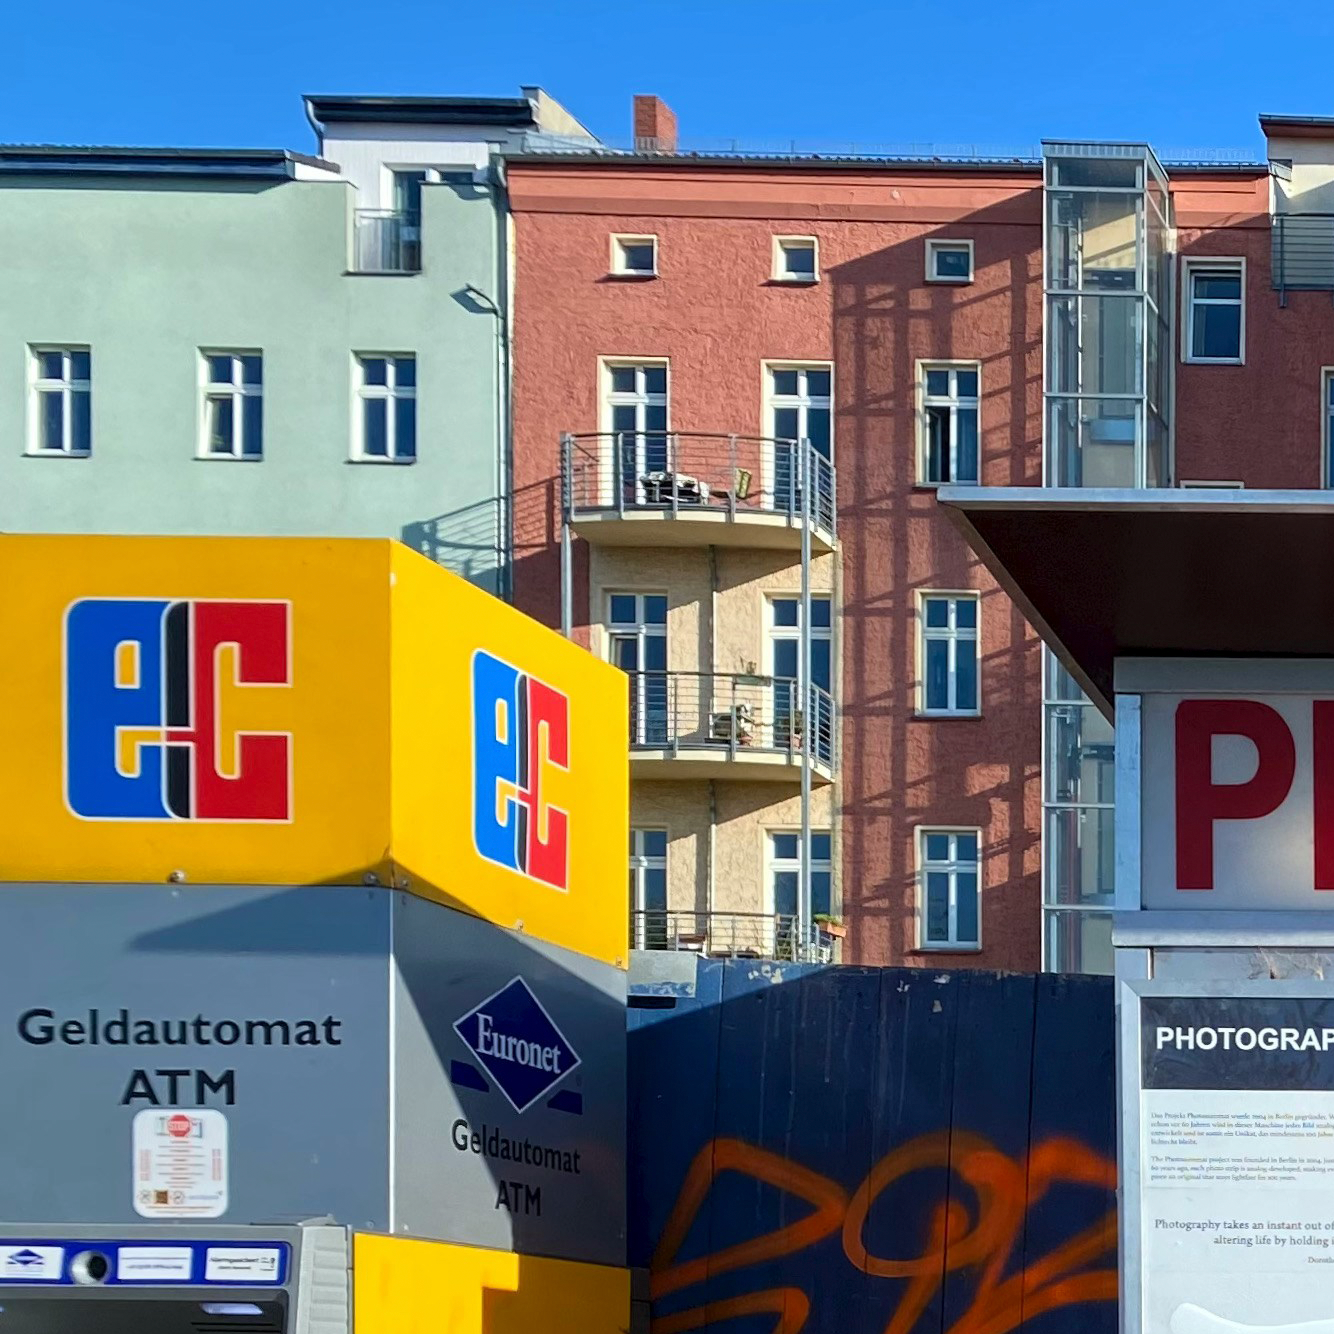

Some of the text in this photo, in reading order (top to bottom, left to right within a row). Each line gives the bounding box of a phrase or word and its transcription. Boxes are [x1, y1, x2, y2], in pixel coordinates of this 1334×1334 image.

[18, 1008, 342, 1046] Geldautomat
[476, 1013, 561, 1073] Euronet
[121, 1070, 236, 1106] ATM
[452, 1119, 580, 1174] Geldautomat
[495, 1180, 541, 1216] ATM
[1155, 1220, 1220, 1231] Photography
[1224, 1221, 1249, 1229] takes
[1267, 1221, 1302, 1230] instant
[1305, 1222, 1321, 1230] out
[1214, 1236, 1253, 1246] altering
[1256, 1236, 1271, 1245] life
[1275, 1236, 1286, 1247] by
[1290, 1237, 1328, 1247] holding
